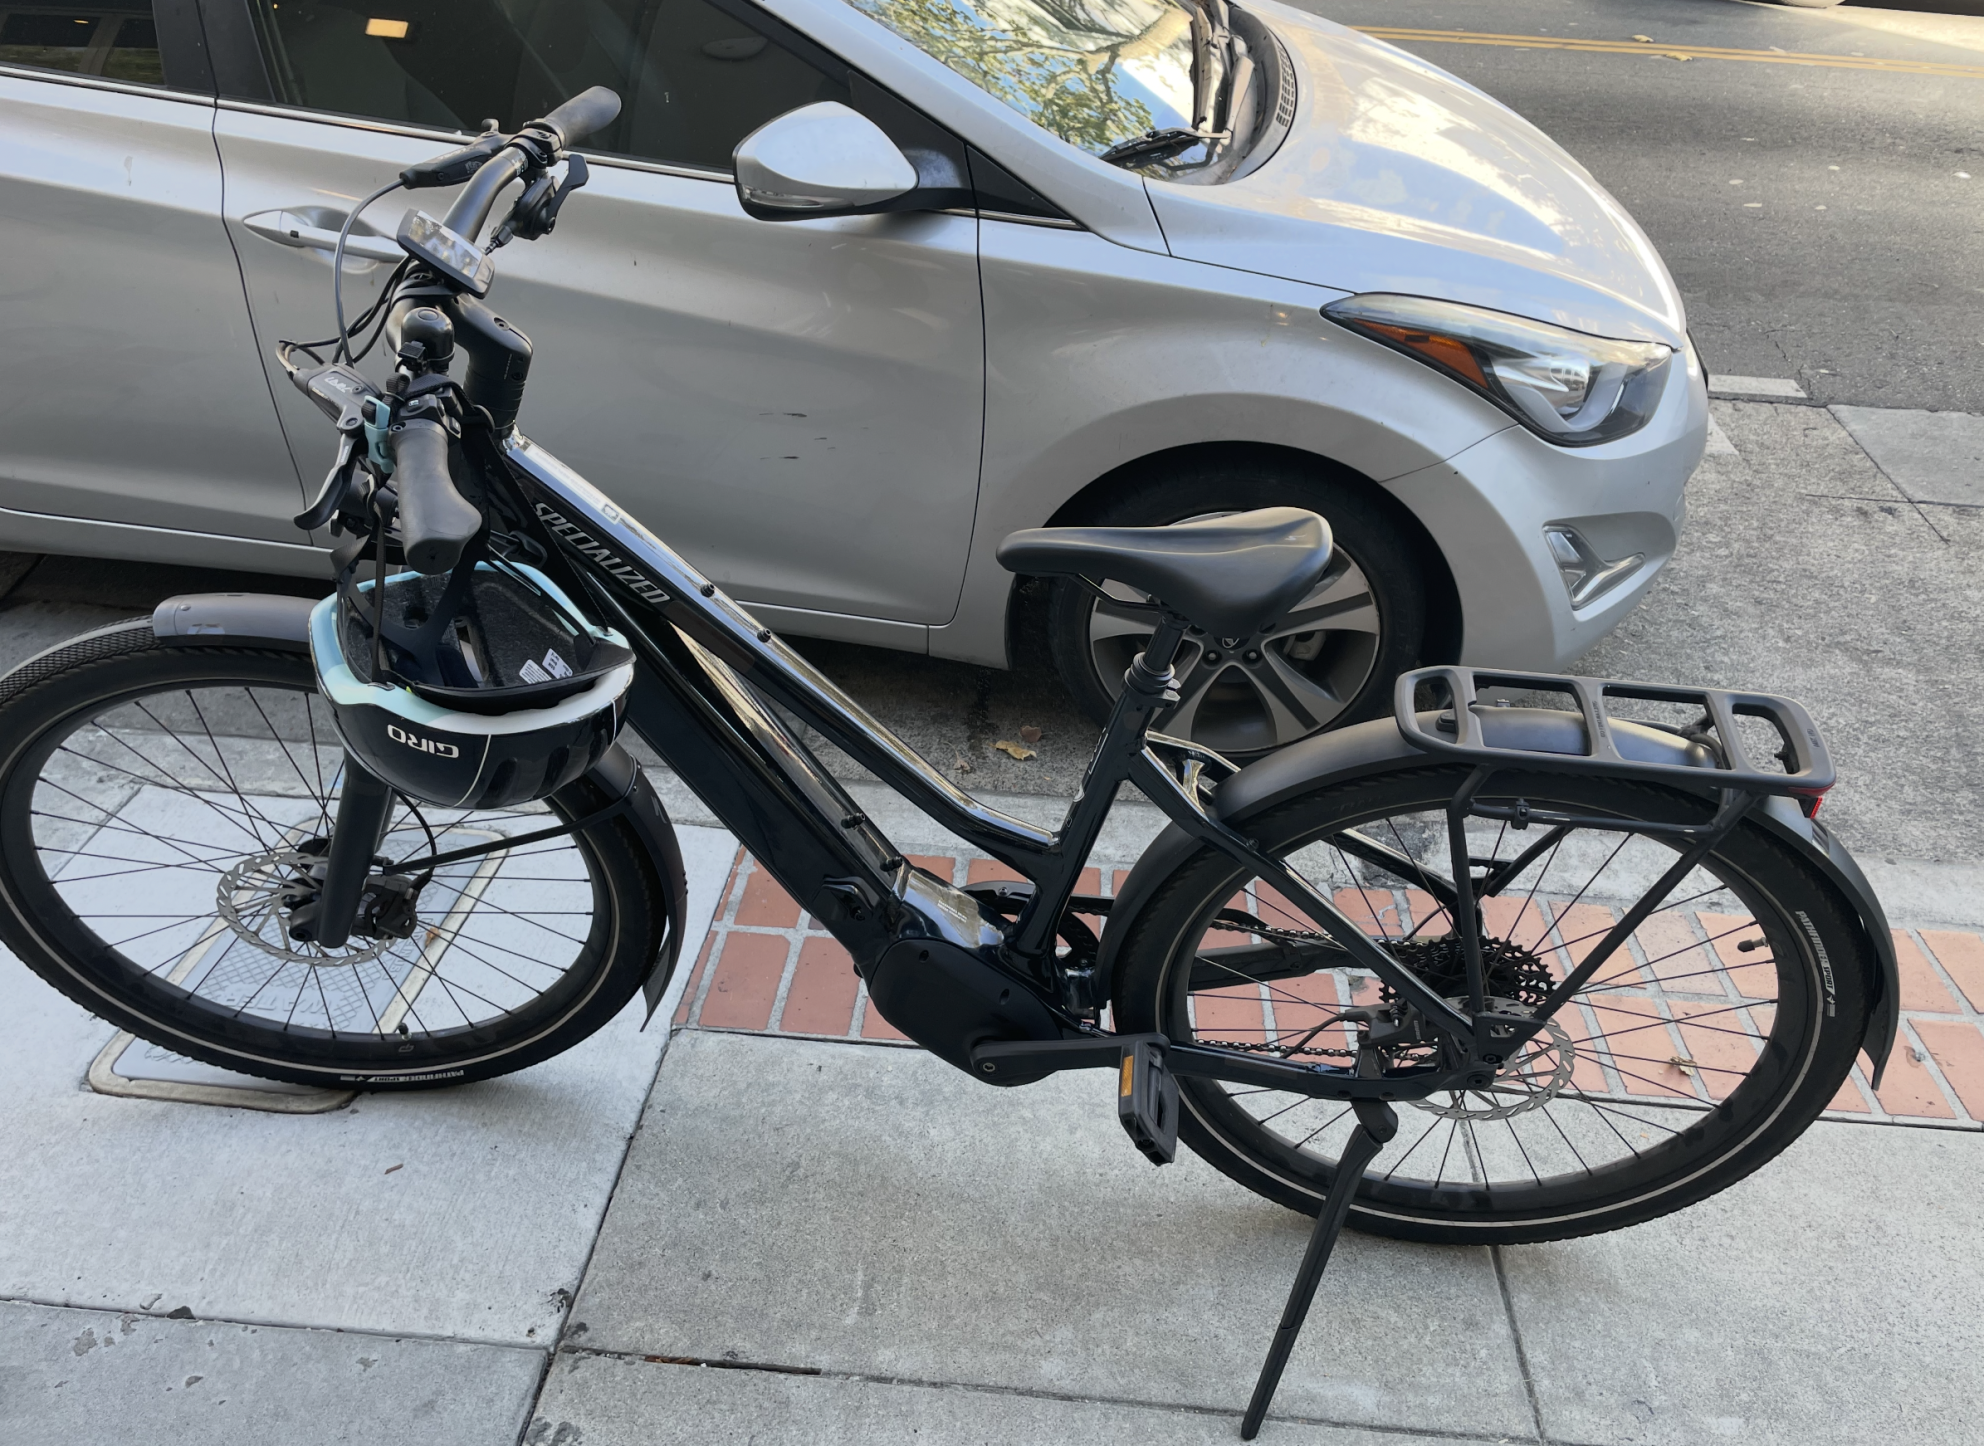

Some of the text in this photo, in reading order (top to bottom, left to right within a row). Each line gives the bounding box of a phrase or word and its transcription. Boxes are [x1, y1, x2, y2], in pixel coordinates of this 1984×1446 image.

[536, 503, 671, 603] SPECIALIZED
[387, 724, 459, 759] GIRO
[1795, 911, 1834, 989] PATHFINDER SPORT
[224, 993, 334, 1015] WATER
